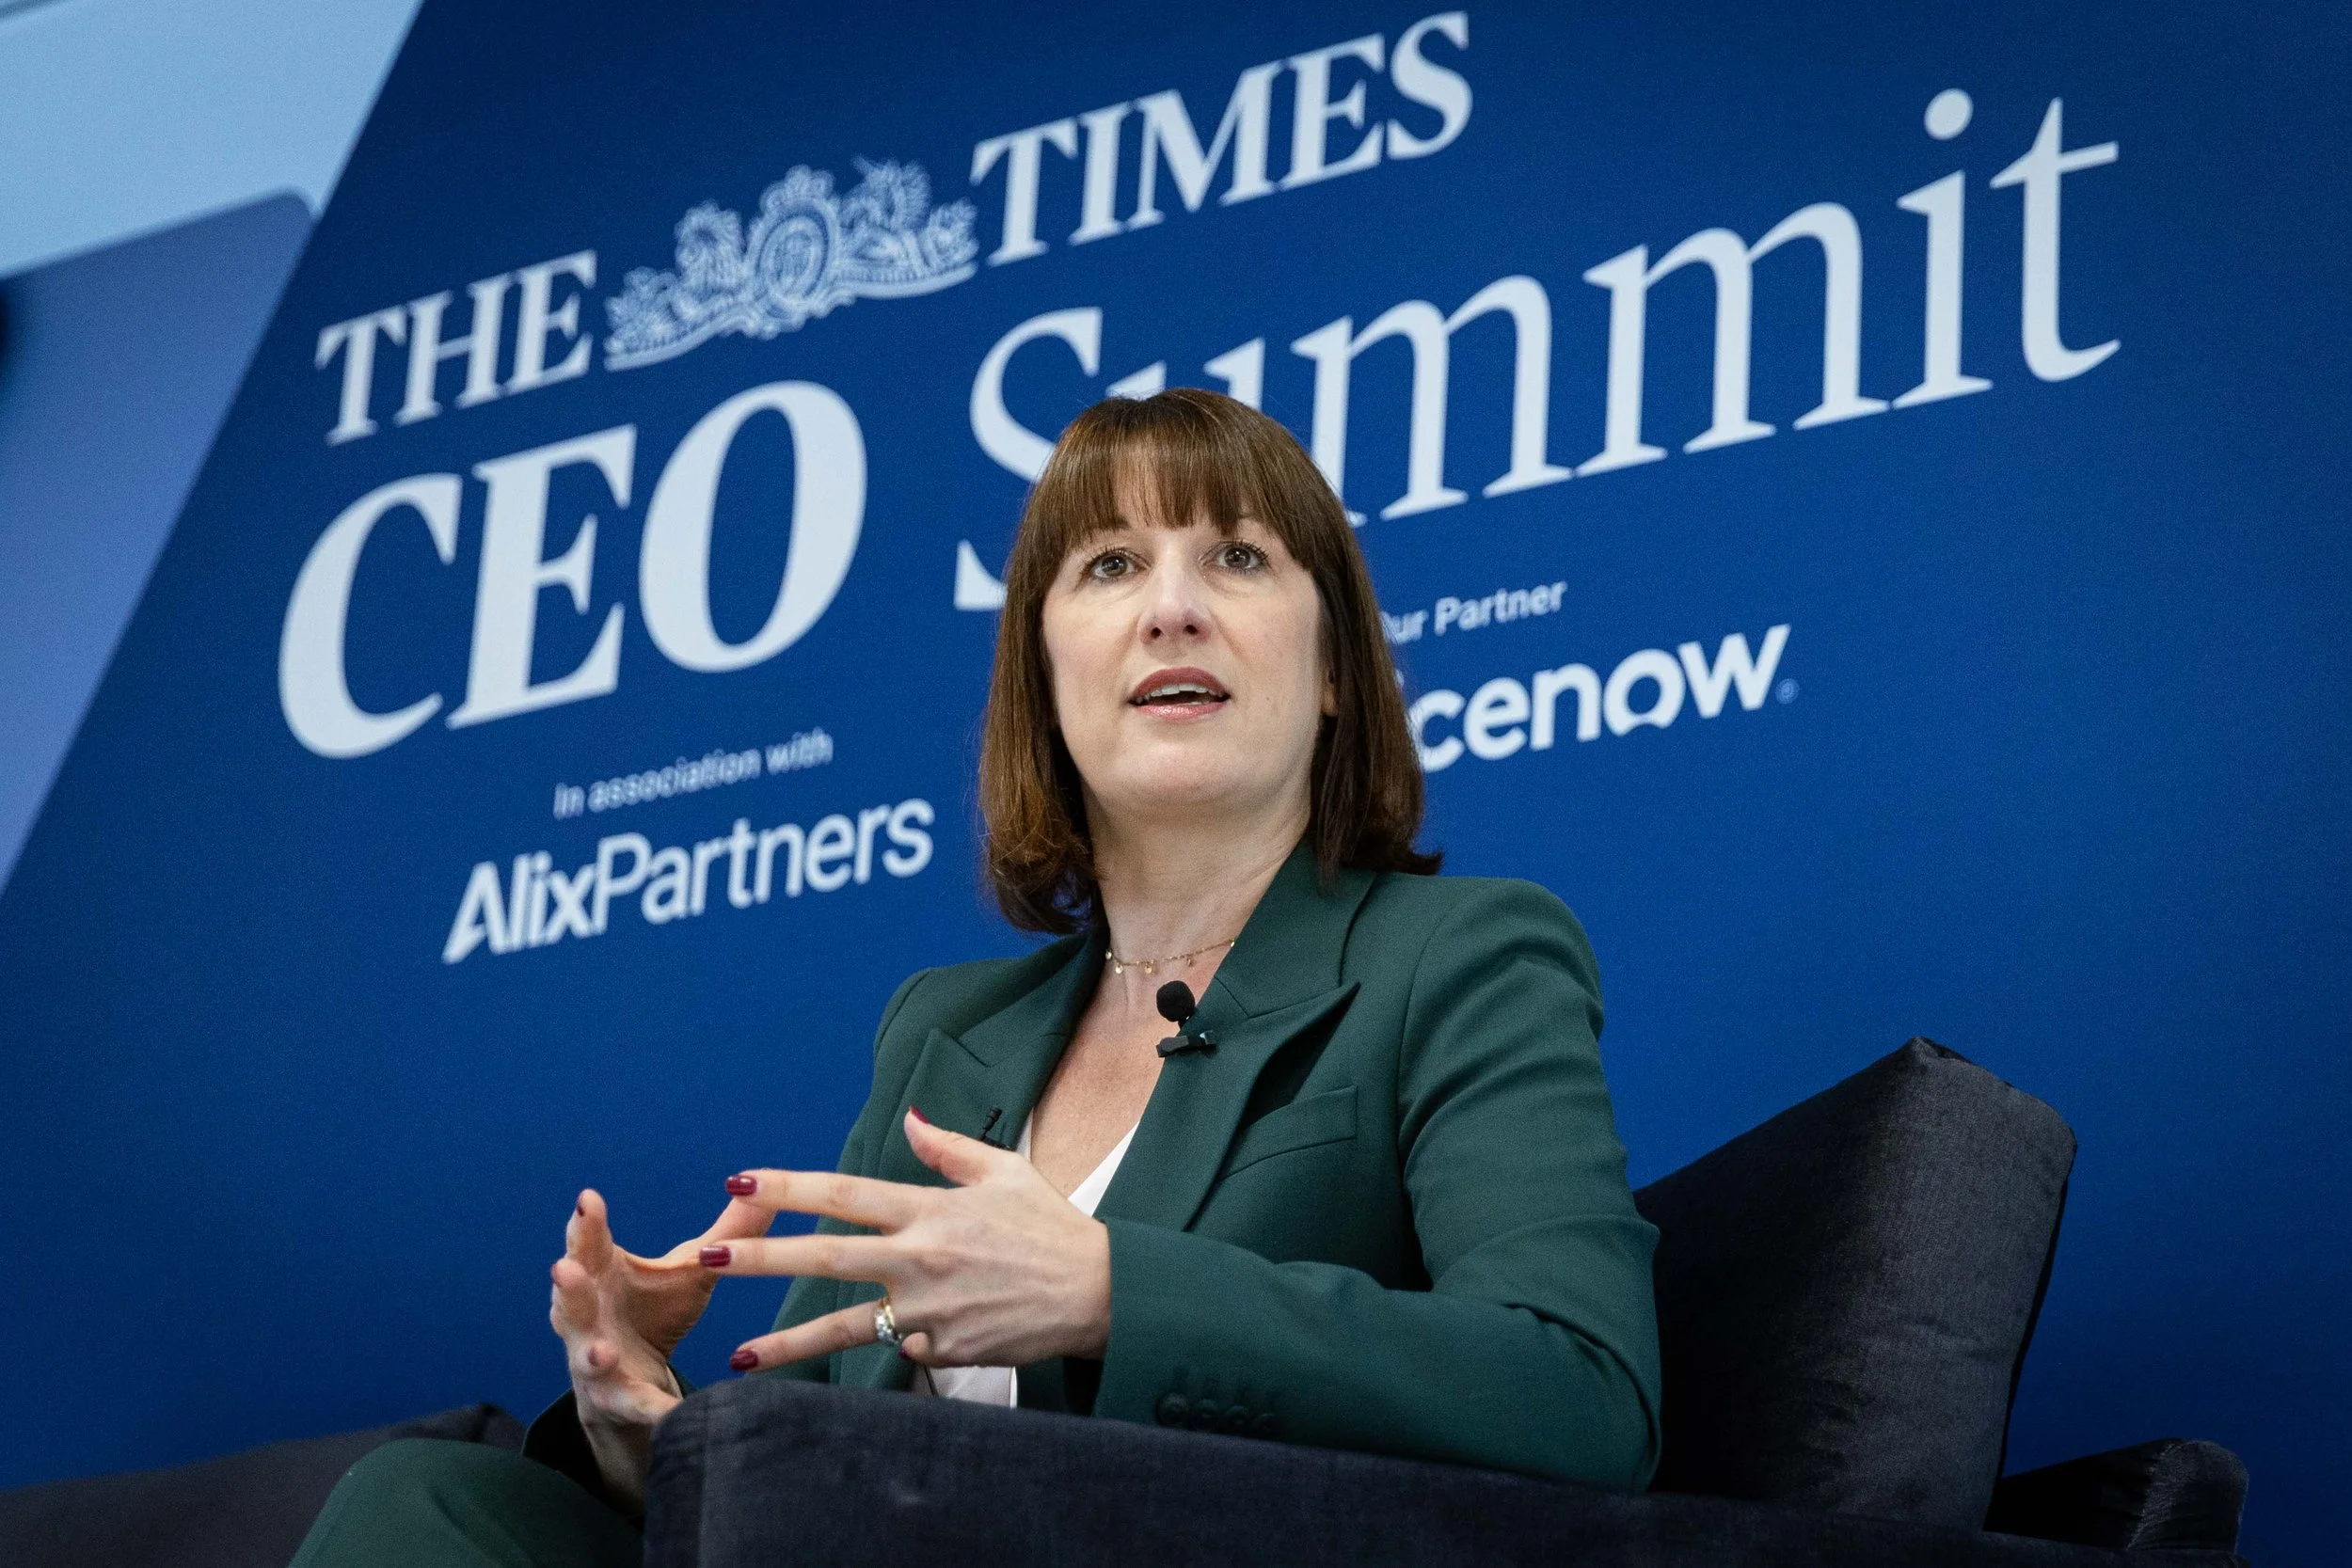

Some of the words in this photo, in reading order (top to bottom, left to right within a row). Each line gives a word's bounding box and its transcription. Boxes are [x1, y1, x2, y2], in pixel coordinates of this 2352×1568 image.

[314, 250, 597, 448] THE
[970, 11, 1472, 266] TIMES
[278, 379, 867, 758] CEO
[954, 87, 2122, 610] Smmit
[1435, 580, 1567, 637] Partner
[553, 783, 585, 819] In
[587, 749, 761, 814] association
[765, 727, 834, 774] with
[442, 799, 935, 964] AlixPartners
